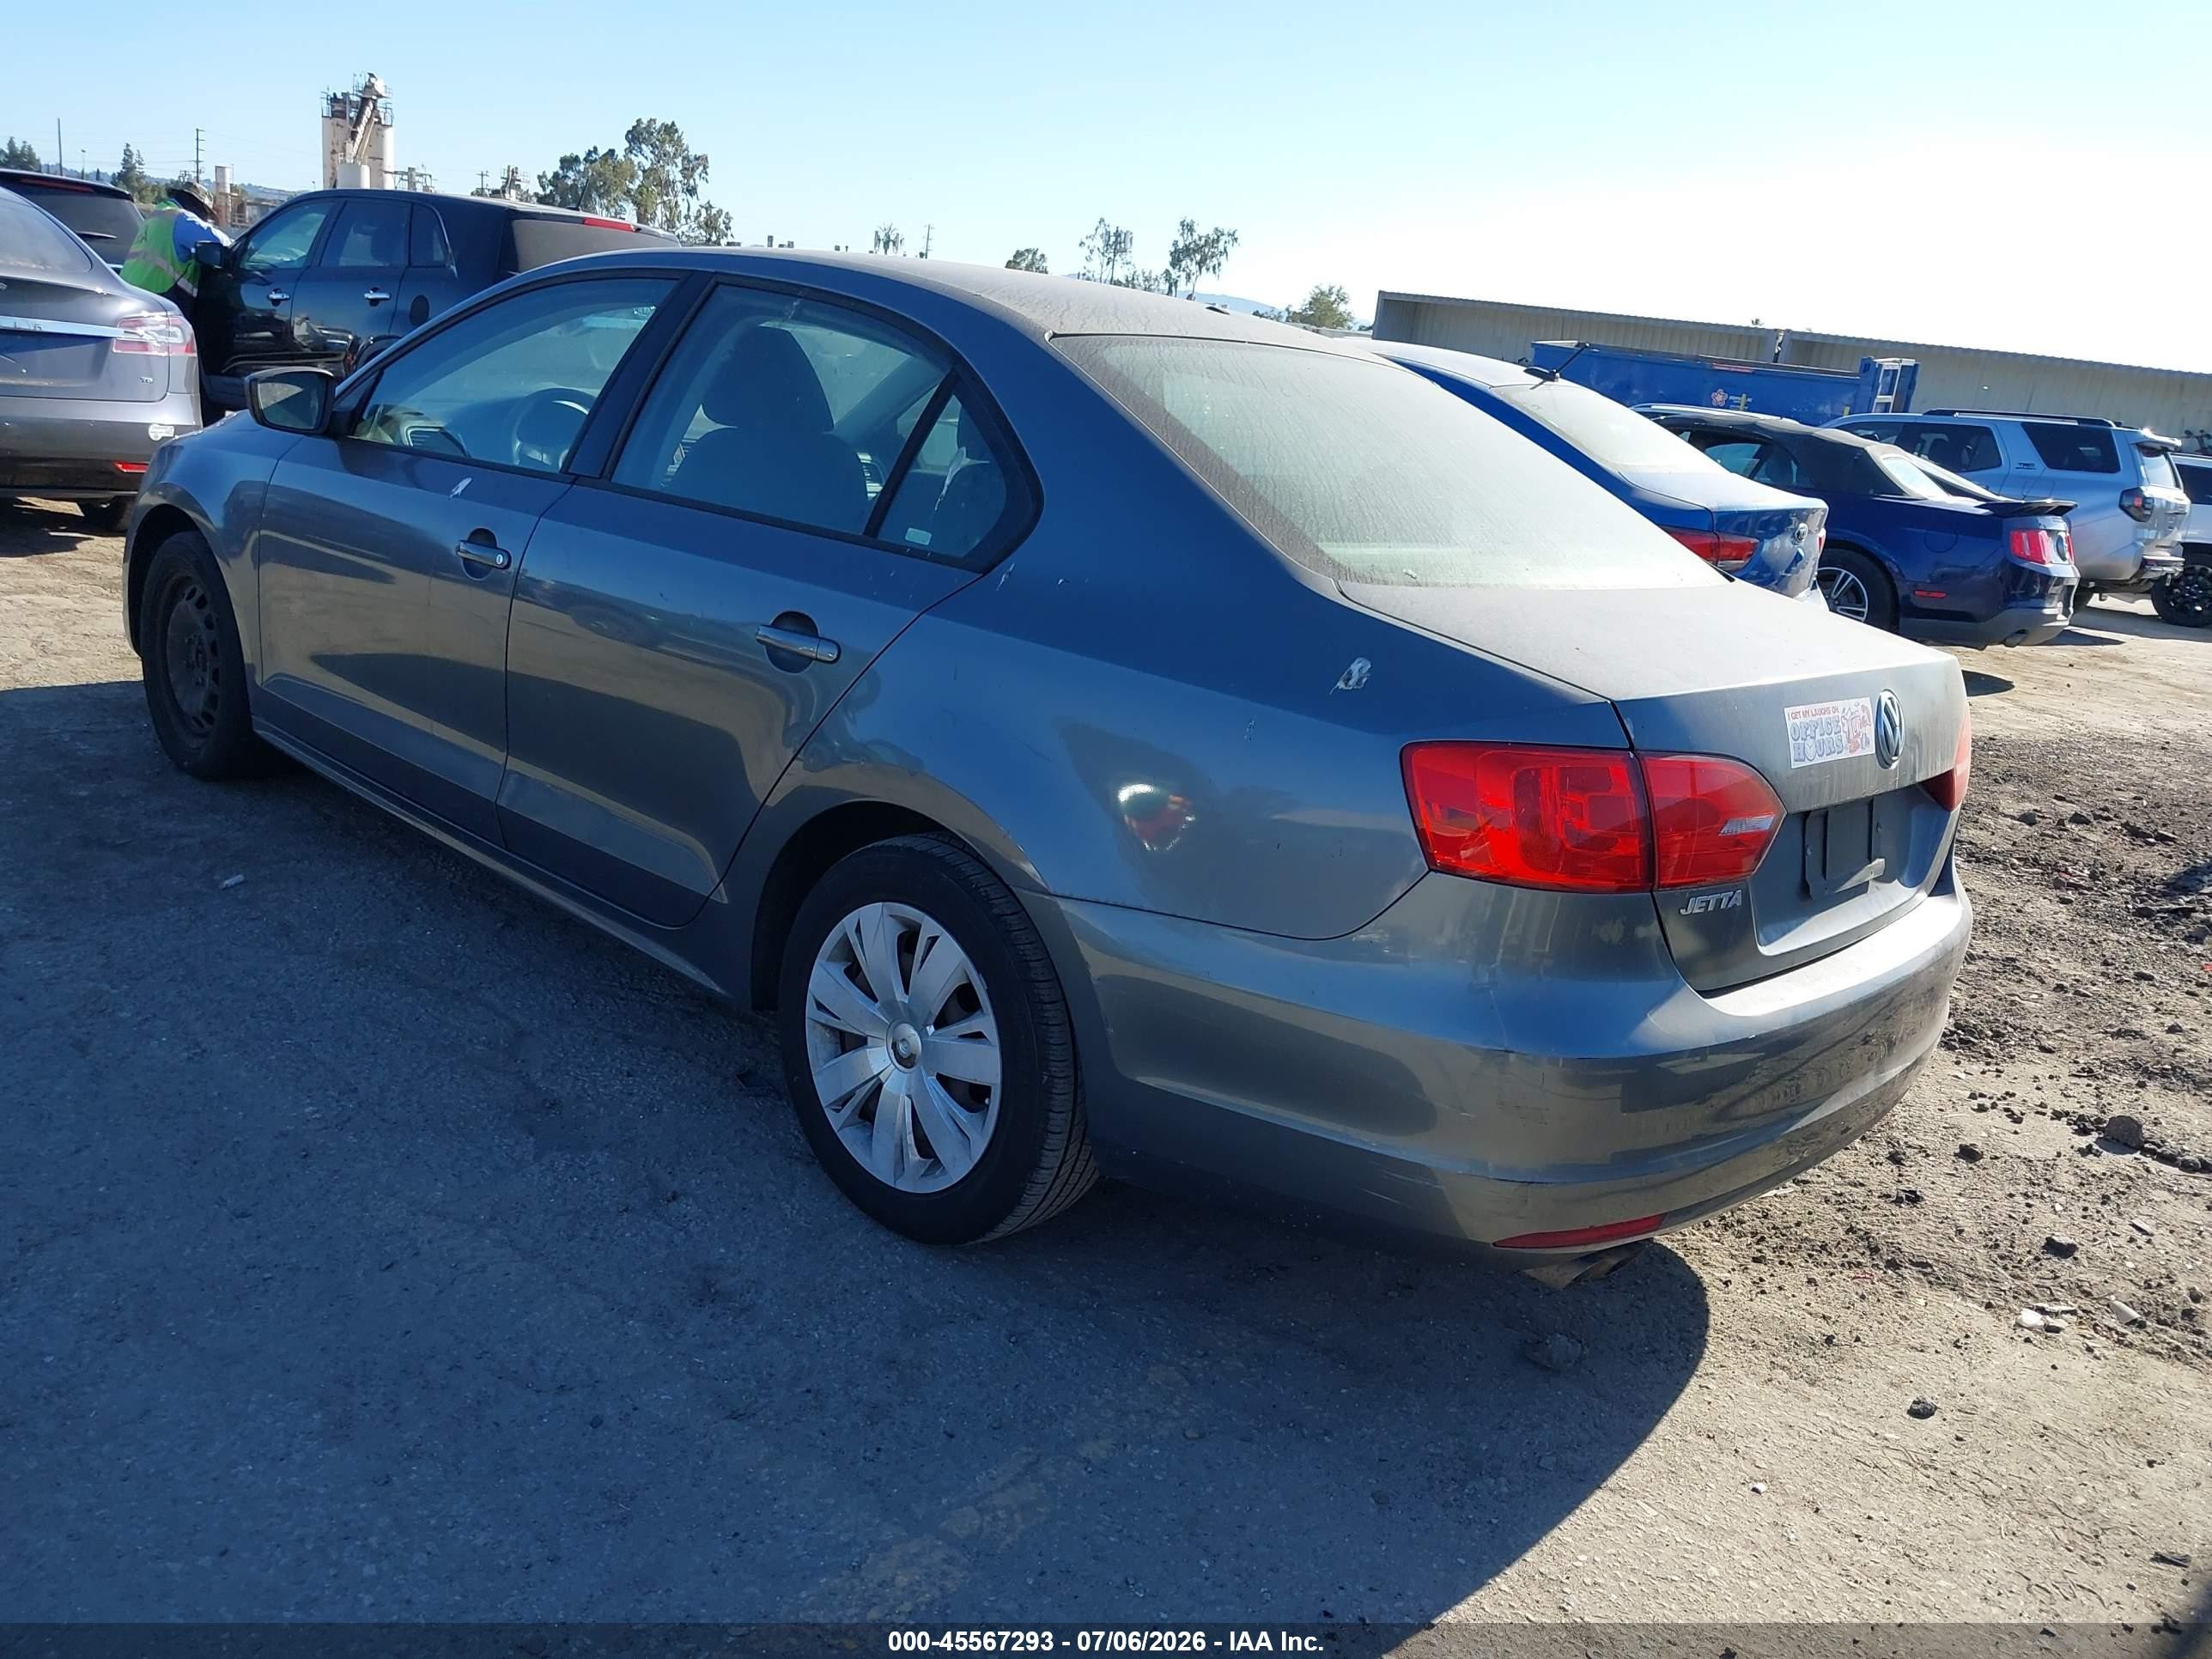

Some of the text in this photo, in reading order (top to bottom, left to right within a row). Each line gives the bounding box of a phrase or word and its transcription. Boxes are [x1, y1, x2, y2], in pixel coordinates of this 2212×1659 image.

[1791, 710, 1802, 720] GET
[1802, 708, 1810, 719] MY
[1810, 707, 1832, 718] LAUGHS
[1790, 715, 1842, 741] OFFICE
[1680, 890, 1742, 915] JETTA
